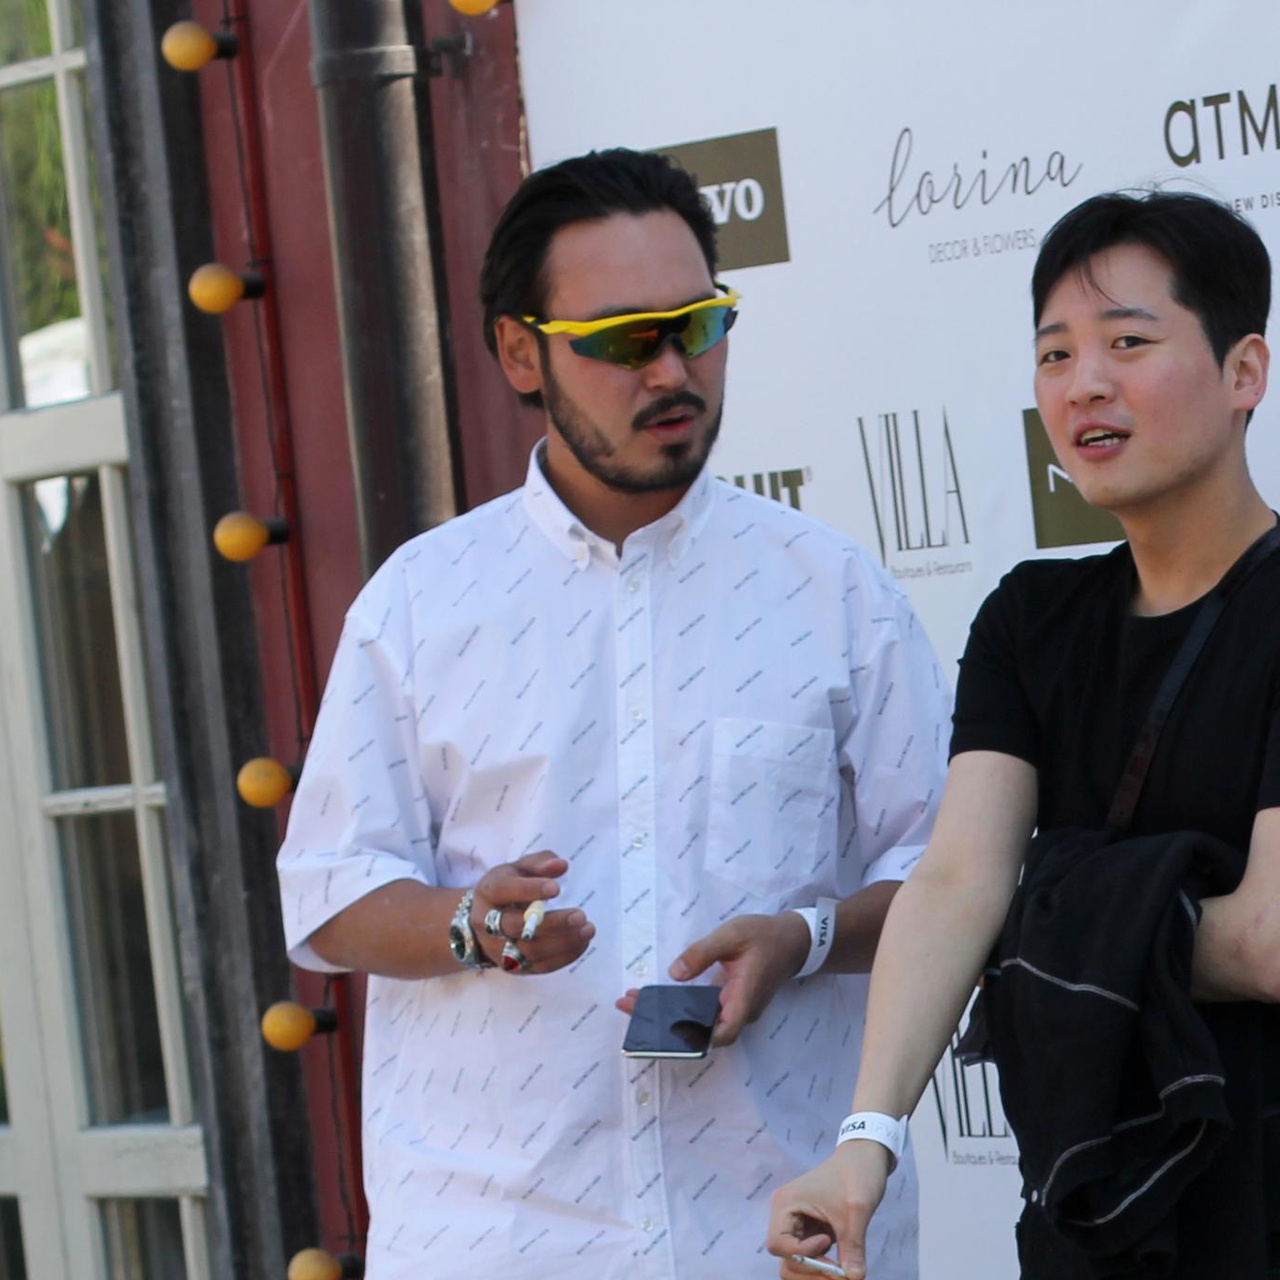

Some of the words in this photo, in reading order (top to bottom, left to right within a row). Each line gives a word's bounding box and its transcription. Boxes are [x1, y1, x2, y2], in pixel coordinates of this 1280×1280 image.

[873, 127, 1083, 228] lorina
[857, 404, 970, 569] VILLA
[818, 916, 828, 947] VISA
